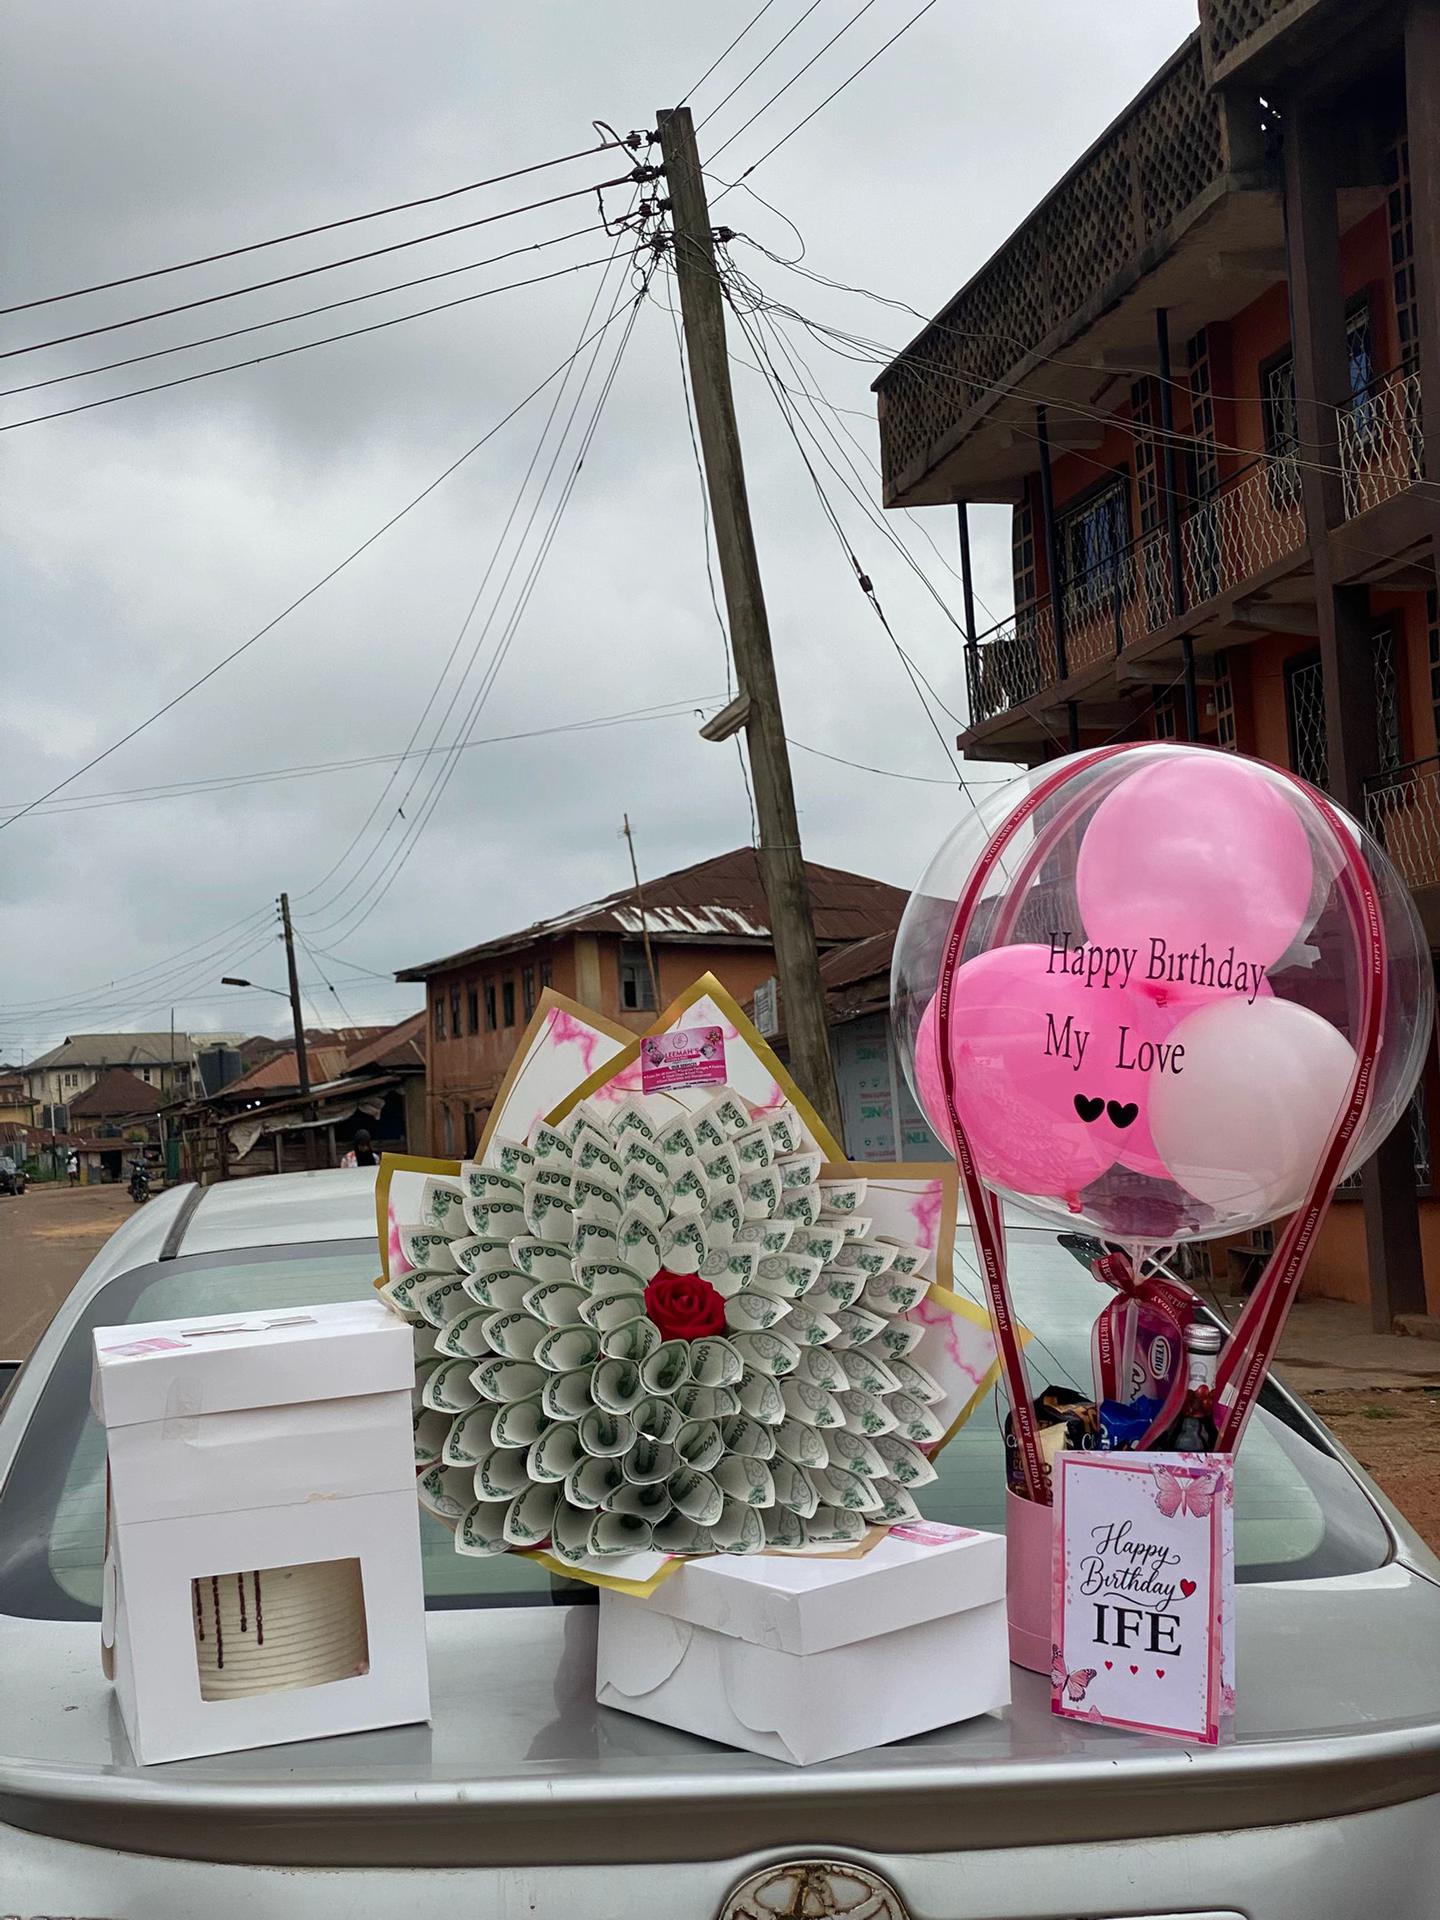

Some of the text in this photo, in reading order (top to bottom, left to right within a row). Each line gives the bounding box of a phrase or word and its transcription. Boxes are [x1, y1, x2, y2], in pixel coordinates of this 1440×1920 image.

[1046, 932, 1266, 1005] Happy Birthday
[1044, 1013, 1185, 1074] My Love
[1341, 1056, 1372, 1139] HAPPY BIRTHDAY
[1283, 1206, 1319, 1284] HAPPY BIRTHDAY
[984, 1248, 1008, 1331] HAPPY BIRTHDAY
[1101, 1317, 1112, 1364] BIRTHDAY
[1231, 1352, 1264, 1428] HAPPY BIRTHDAY
[1019, 1407, 1041, 1490] HAPPY BIRTHDAY
[1091, 1520, 1181, 1570] Happy
[1080, 1556, 1180, 1612] Birthday
[1093, 1603, 1182, 1656] IFE
